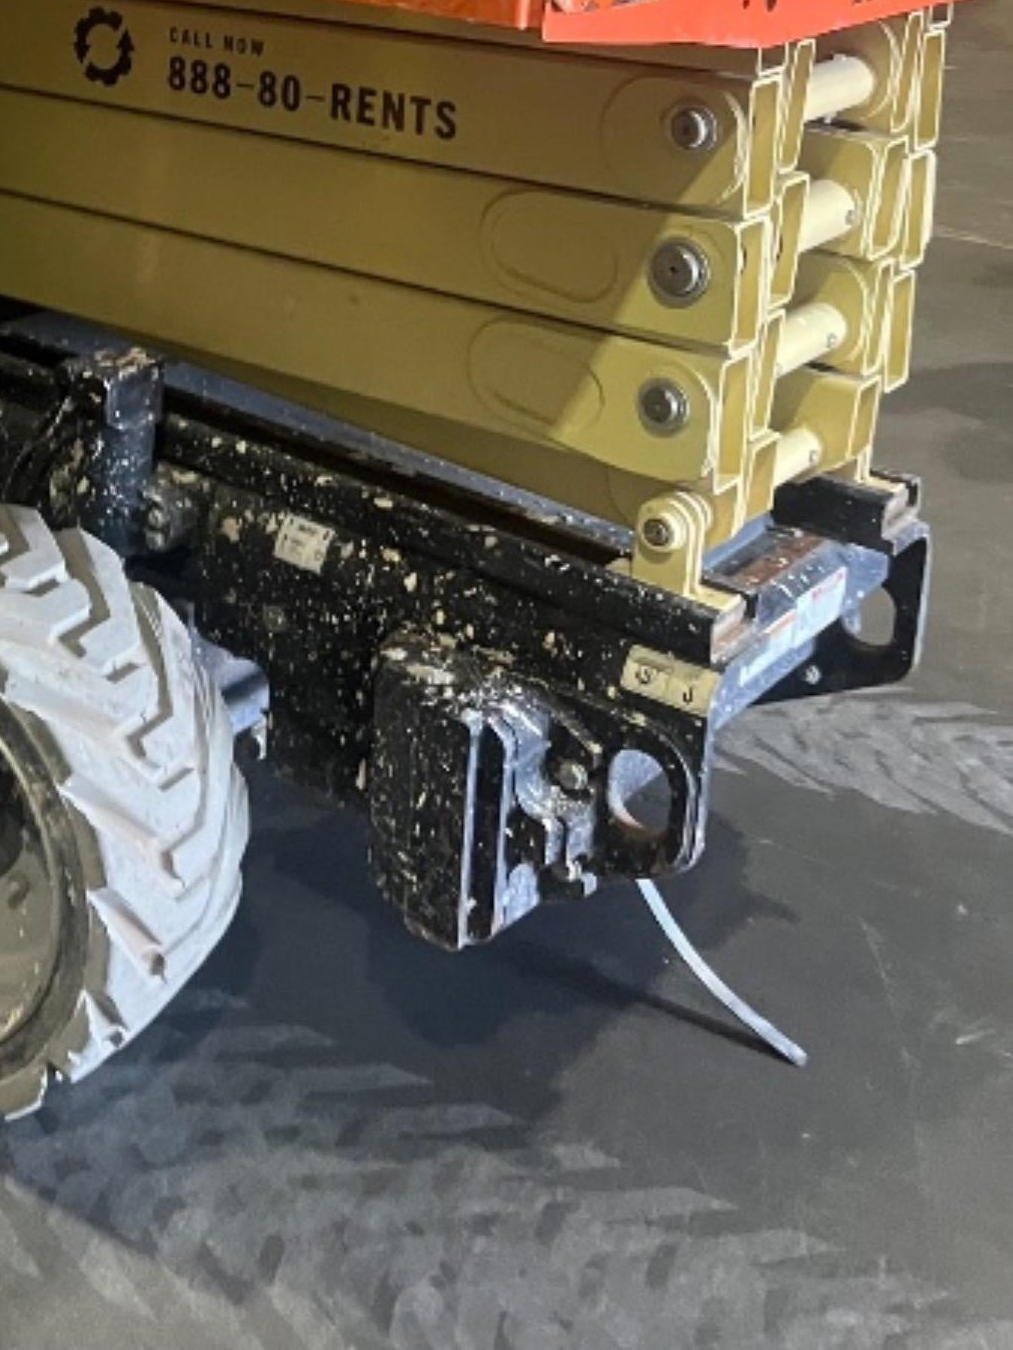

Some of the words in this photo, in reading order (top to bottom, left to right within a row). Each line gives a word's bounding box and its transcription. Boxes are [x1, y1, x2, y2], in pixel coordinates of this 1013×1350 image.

[169, 25, 213, 49] CALL
[223, 34, 265, 58] NOW
[167, 55, 458, 141] 888-80-RENTS
